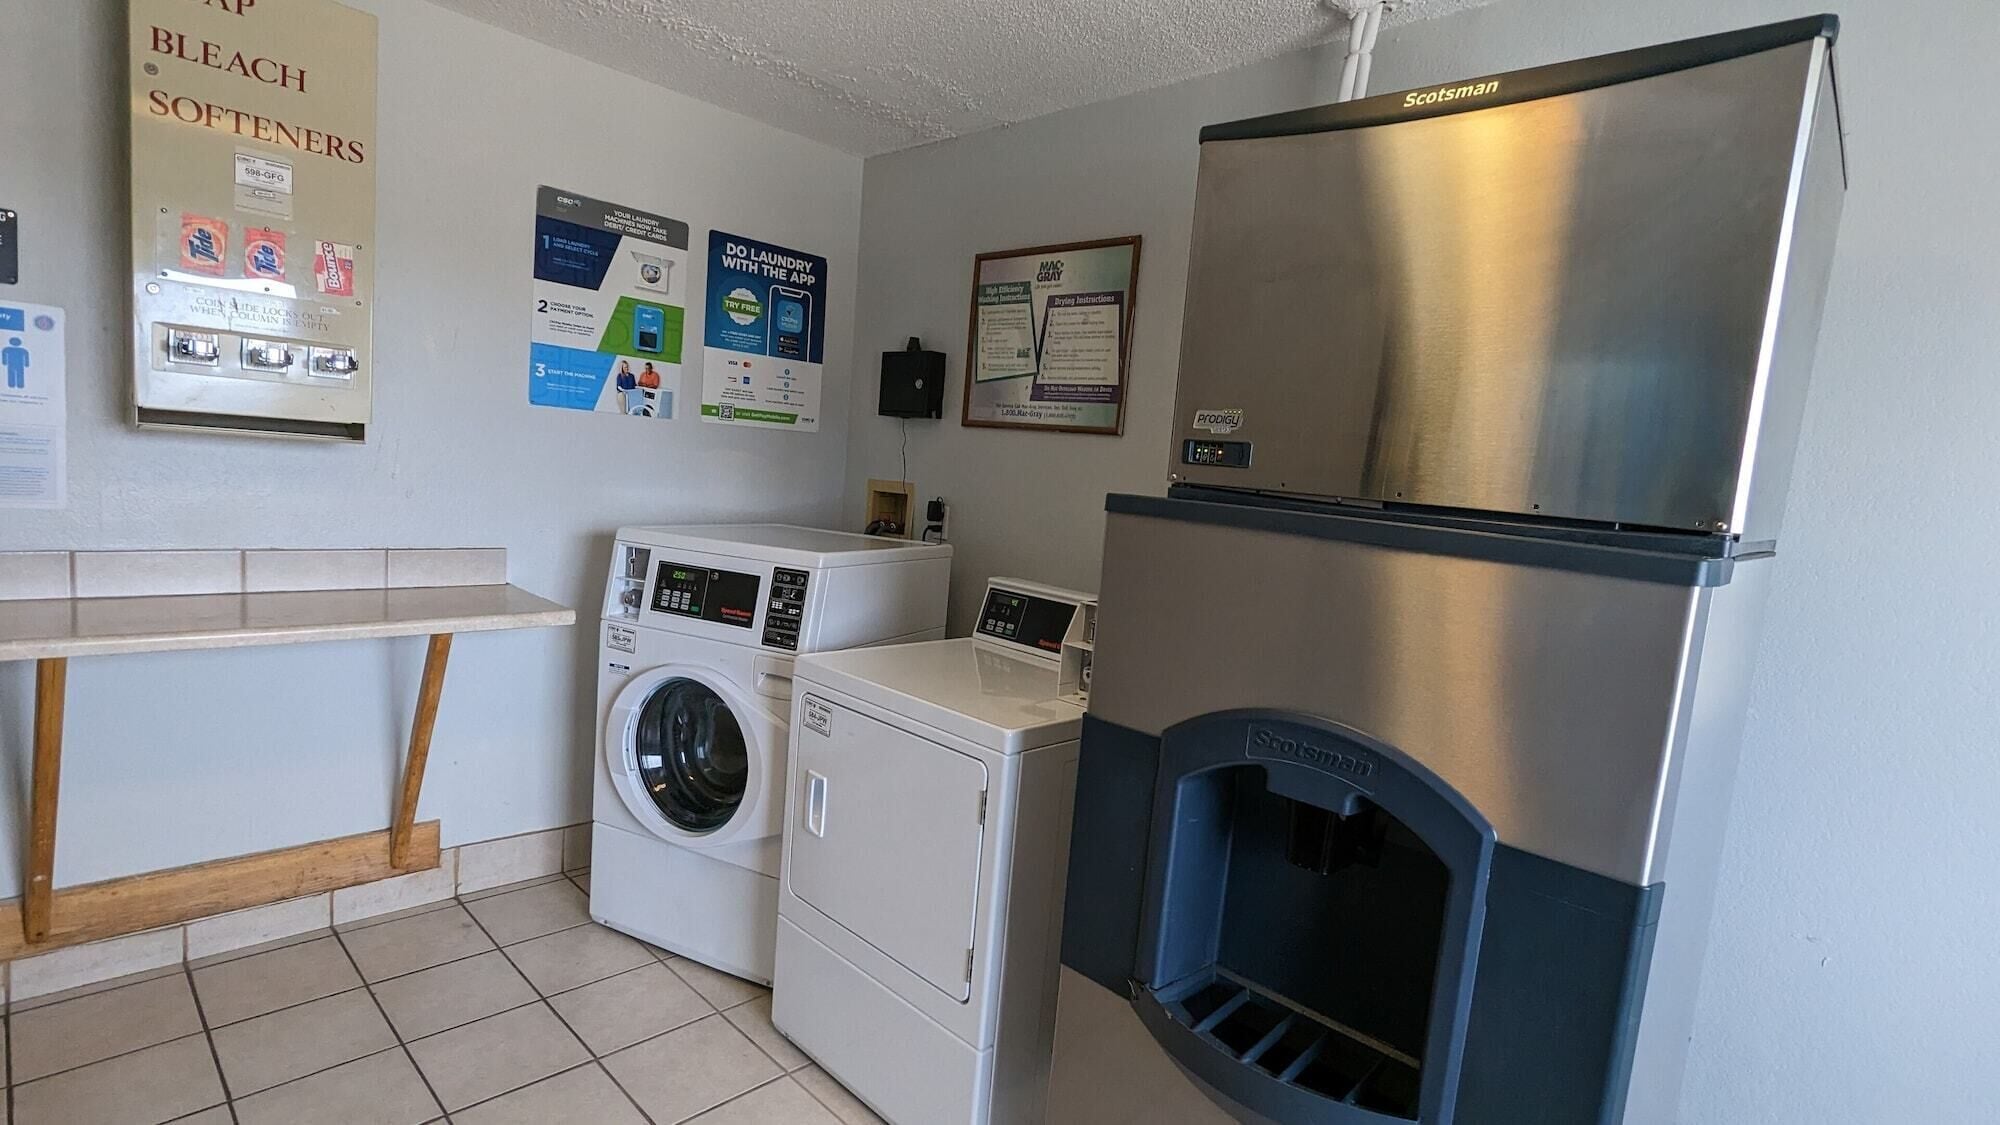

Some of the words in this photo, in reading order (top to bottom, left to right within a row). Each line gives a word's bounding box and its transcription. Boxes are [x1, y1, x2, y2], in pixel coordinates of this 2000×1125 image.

[150, 25, 307, 93] BLEACH
[1403, 80, 1499, 107] Scotsman
[148, 89, 364, 164] SOFTENERS
[244, 167, 285, 182] 598-GFG
[604, 214, 636, 228] MACHINES
[636, 221, 653, 231] NOW
[652, 225, 668, 235] TAKE
[613, 209, 631, 221] YOUR
[632, 213, 660, 227] LAUNDRY
[542, 234, 550, 249] 1
[625, 225, 647, 237] CREDIT
[647, 230, 667, 242] CARDS
[188, 227, 219, 264] Tide
[254, 244, 281, 276] Tide
[726, 241, 748, 258] DO
[750, 248, 813, 273] LAUNDRY
[721, 254, 759, 275] WITH
[761, 264, 788, 281] THE
[789, 271, 816, 286] APP
[1036, 270, 1064, 283] GRAY
[537, 299, 548, 314] 2
[724, 300, 740, 310] TRY
[741, 303, 762, 314] FREE
[1054, 296, 1075, 307] Drying
[1076, 294, 1115, 305] Instructions
[190, 305, 226, 318] WHEN
[230, 310, 280, 326] COLUMN
[262, 304, 298, 319] LOCKS
[535, 363, 546, 377] 3
[1254, 729, 1373, 777] Scotsman
